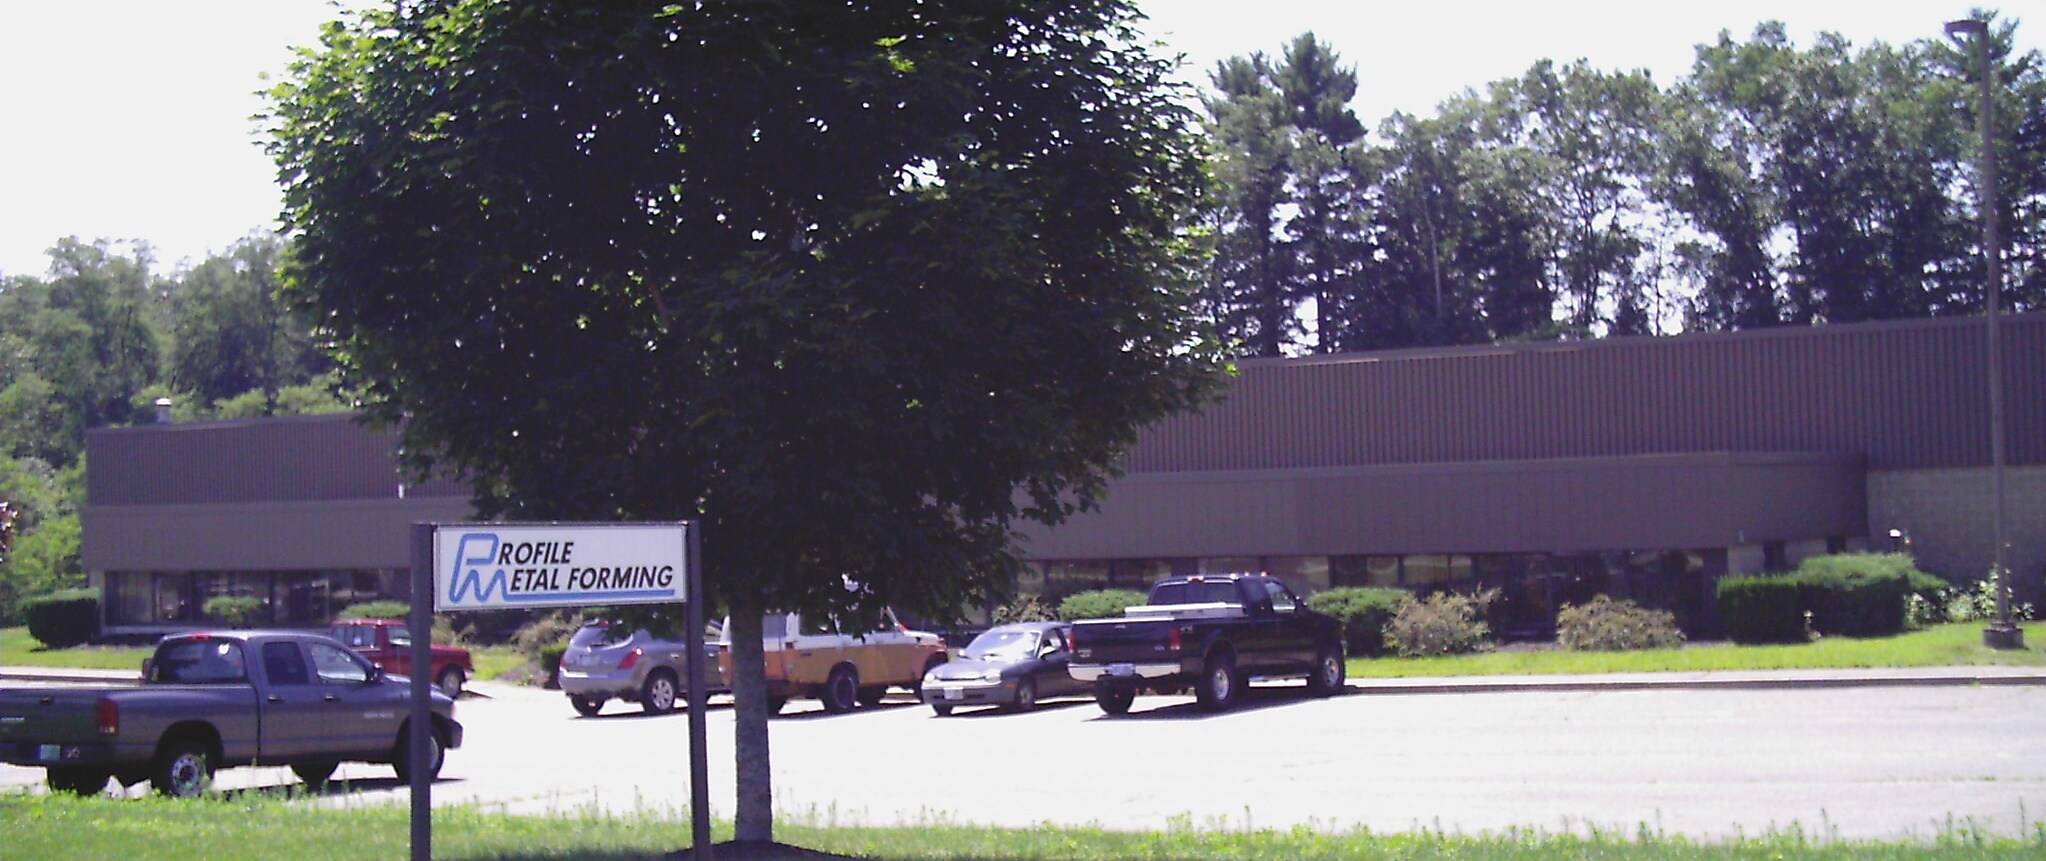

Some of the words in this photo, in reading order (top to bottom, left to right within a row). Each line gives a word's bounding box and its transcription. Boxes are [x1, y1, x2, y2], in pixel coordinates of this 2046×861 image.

[453, 533, 574, 566] PROFILE
[450, 569, 560, 603] METAL
[567, 565, 673, 590] FORMING
